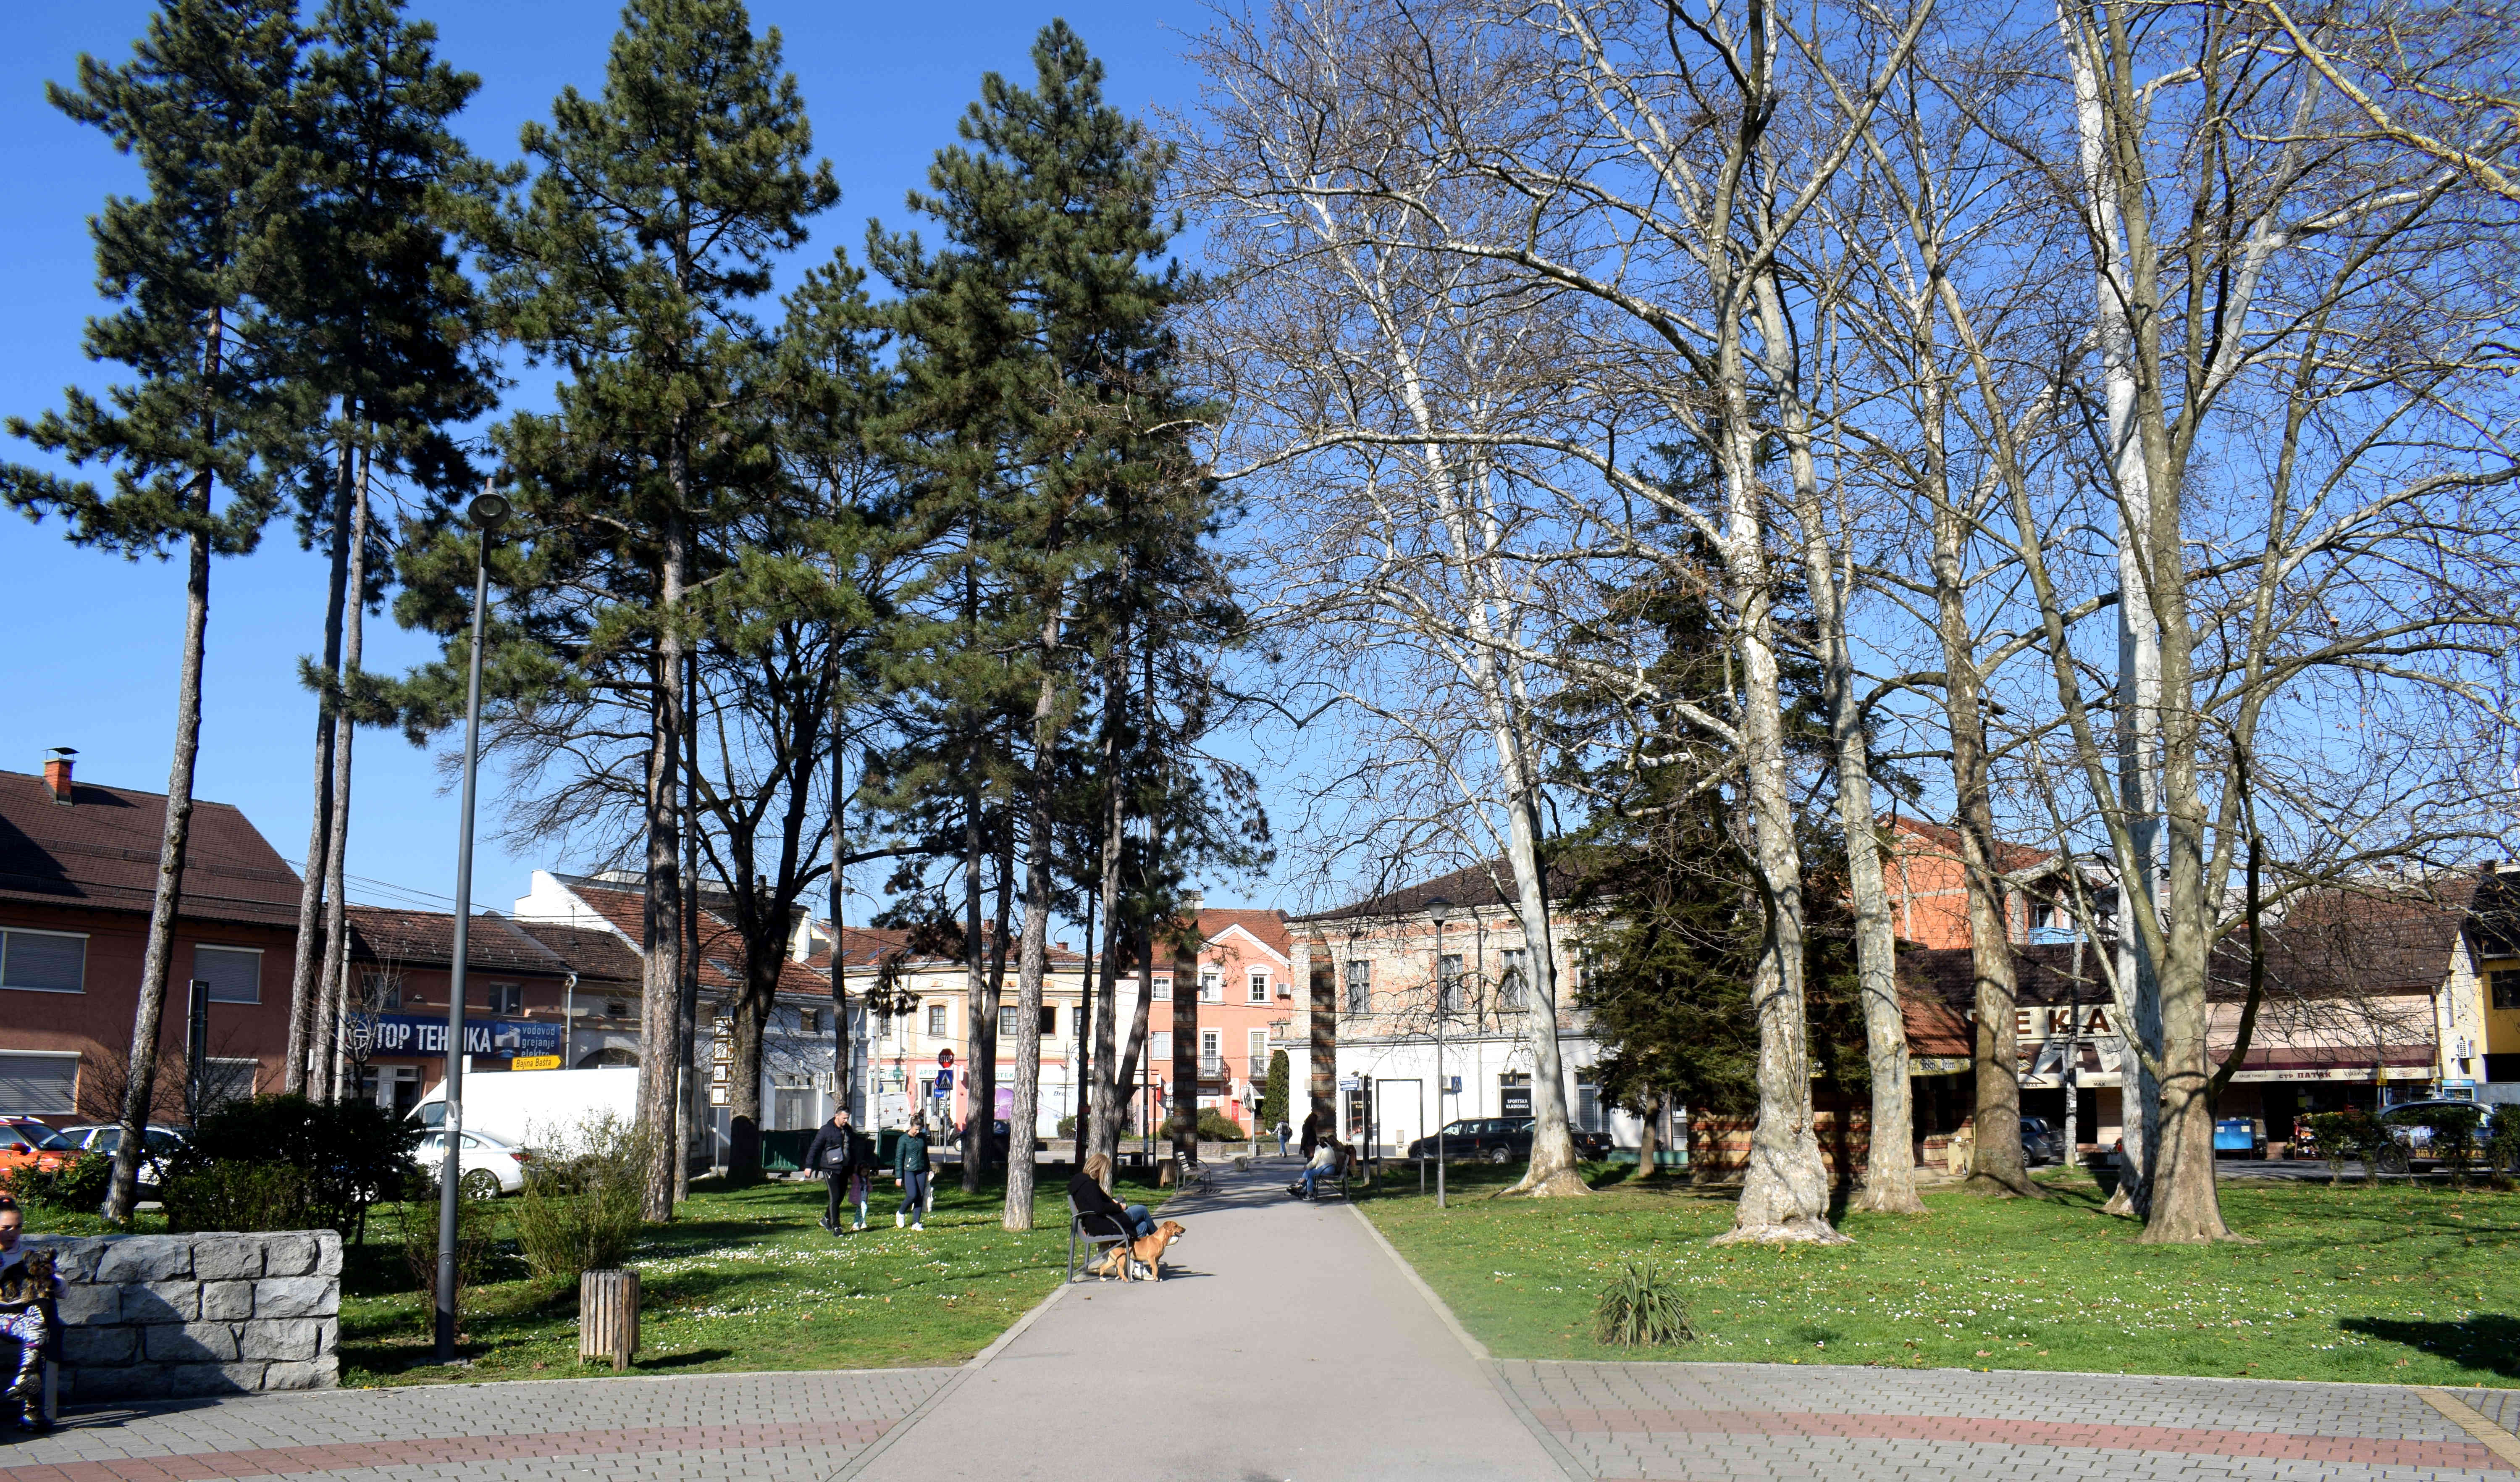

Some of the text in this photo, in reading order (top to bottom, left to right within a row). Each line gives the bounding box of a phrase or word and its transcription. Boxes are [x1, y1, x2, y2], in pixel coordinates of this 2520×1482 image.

[522, 1025, 555, 1035] vodovod
[377, 1022, 491, 1052] TOP TEHIKA
[522, 1037, 555, 1049] grejanje
[516, 1059, 533, 1069] Bajina
[1921, 1059, 1935, 1070] Jelen
[1941, 1059, 1956, 1070] Jelen
